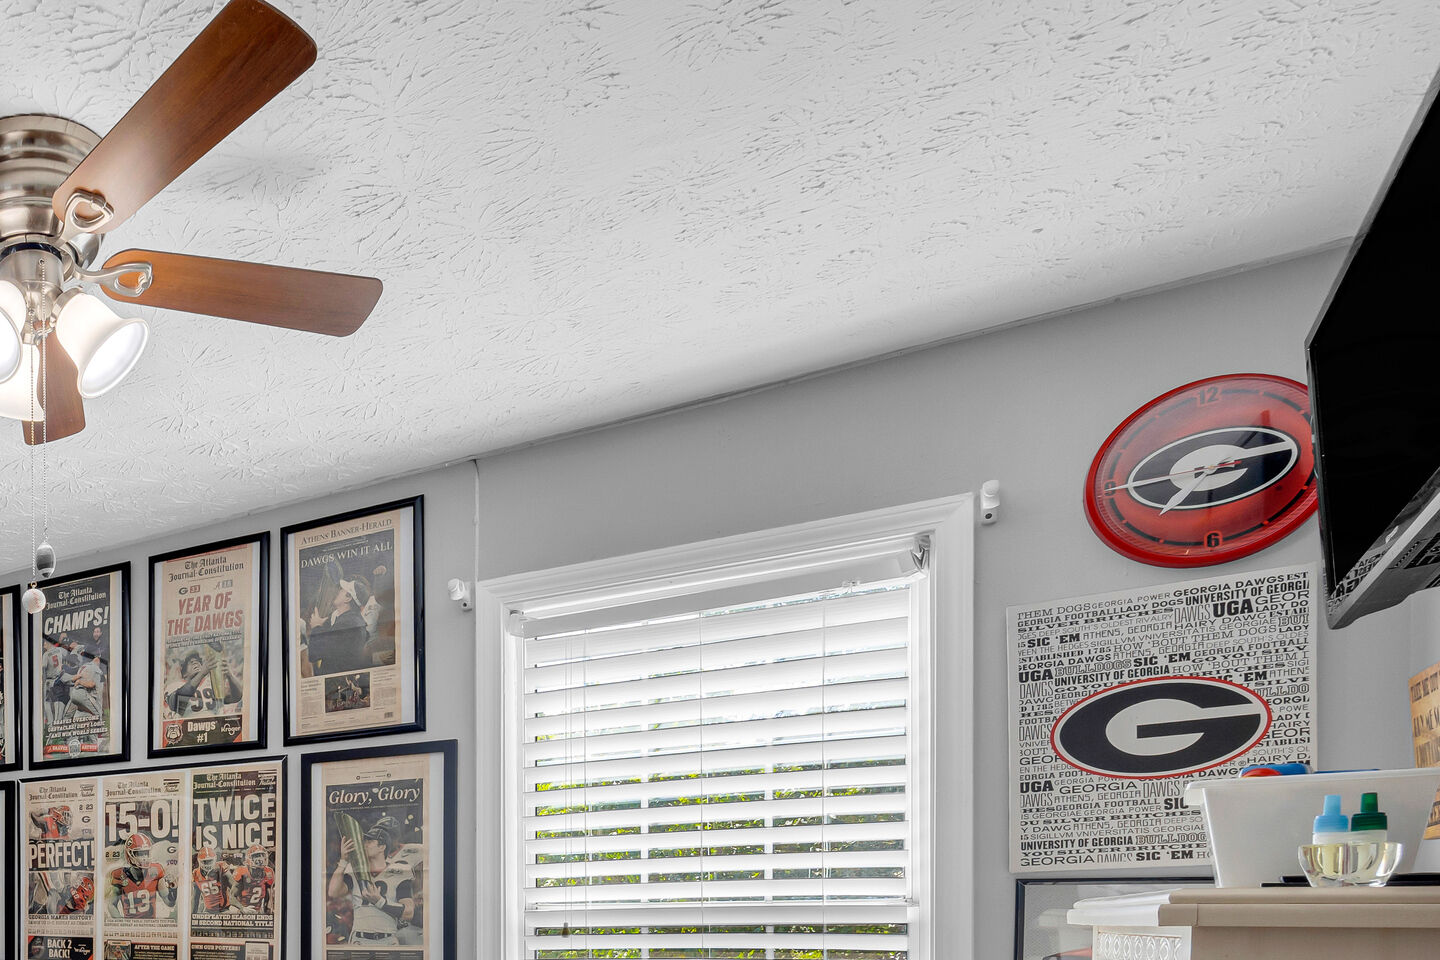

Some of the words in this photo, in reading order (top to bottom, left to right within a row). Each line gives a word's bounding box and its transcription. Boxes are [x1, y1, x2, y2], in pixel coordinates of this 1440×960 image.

[1197, 386, 1220, 404] 12
[301, 532, 329, 545] ATHENS
[330, 519, 392, 538] BANNER-HERALD
[199, 556, 227, 568] Atlanta
[301, 553, 335, 568] DAWGS
[337, 548, 358, 560] WIN
[360, 546, 371, 556] IT
[373, 541, 393, 552] ALL
[178, 594, 212, 616] YEAR
[214, 591, 233, 610] OF
[1018, 608, 1053, 620] THEM
[1057, 602, 1091, 614] DOGS
[1137, 593, 1171, 602] POWER
[1173, 583, 1231, 597] GEORGIA
[1235, 575, 1284, 588] DAWGS
[1018, 616, 1062, 628] GEORGIA
[1152, 599, 1184, 609] DOGS
[1185, 588, 1248, 606] UNIVERSITY
[1250, 585, 1264, 597] OF
[44, 605, 110, 636] CHAMPS!
[167, 617, 192, 636] THE
[194, 609, 244, 633] DAWGS
[1174, 603, 1210, 624] DAWGS
[1213, 598, 1254, 618] UGA
[1174, 618, 1217, 630] HAIRY
[1222, 612, 1267, 624] DAWG
[1027, 637, 1050, 648] SIC
[1127, 621, 1172, 634] GEORGIA
[1114, 642, 1144, 652] HOW
[1191, 630, 1233, 643] THEM
[1239, 625, 1277, 637] DOGS
[1068, 654, 1111, 665] DAWGS
[1088, 647, 1111, 655] 1785
[1018, 668, 1054, 683] UGA
[1055, 658, 1132, 677] BULLDOGS
[1133, 655, 1158, 667] SIC
[1194, 646, 1244, 658] GEORGIA
[1054, 672, 1110, 687] UNIVERSITY
[1113, 669, 1125, 680] OF
[1128, 665, 1170, 678] GEORGIA
[1172, 663, 1204, 674] HOW
[1019, 680, 1054, 700] DAWGS
[196, 732, 208, 743] #1
[221, 723, 241, 735] Kroger
[329, 789, 372, 806] Glory,
[377, 785, 420, 802] Glory
[1020, 780, 1054, 794] UGA
[1060, 781, 1138, 795] GEORGIA
[1143, 780, 1180, 799] DAWGS
[193, 793, 276, 823] TWICE
[1056, 802, 1101, 812] GEORGIA
[1104, 799, 1160, 808] FOOTBALL
[105, 800, 179, 842] 15-0!
[195, 825, 218, 850] IS
[222, 821, 274, 849] NICE
[1020, 838, 1077, 851] UNIVERSITY
[1078, 837, 1090, 848] OF
[1092, 836, 1133, 847] GEORGIA
[29, 839, 95, 869] PERFECT!
[1136, 852, 1161, 861] SIC
[127, 889, 151, 915] 13
[47, 939, 66, 949] BACK
[67, 939, 72, 948] 2
[48, 949, 71, 959] BACK!
